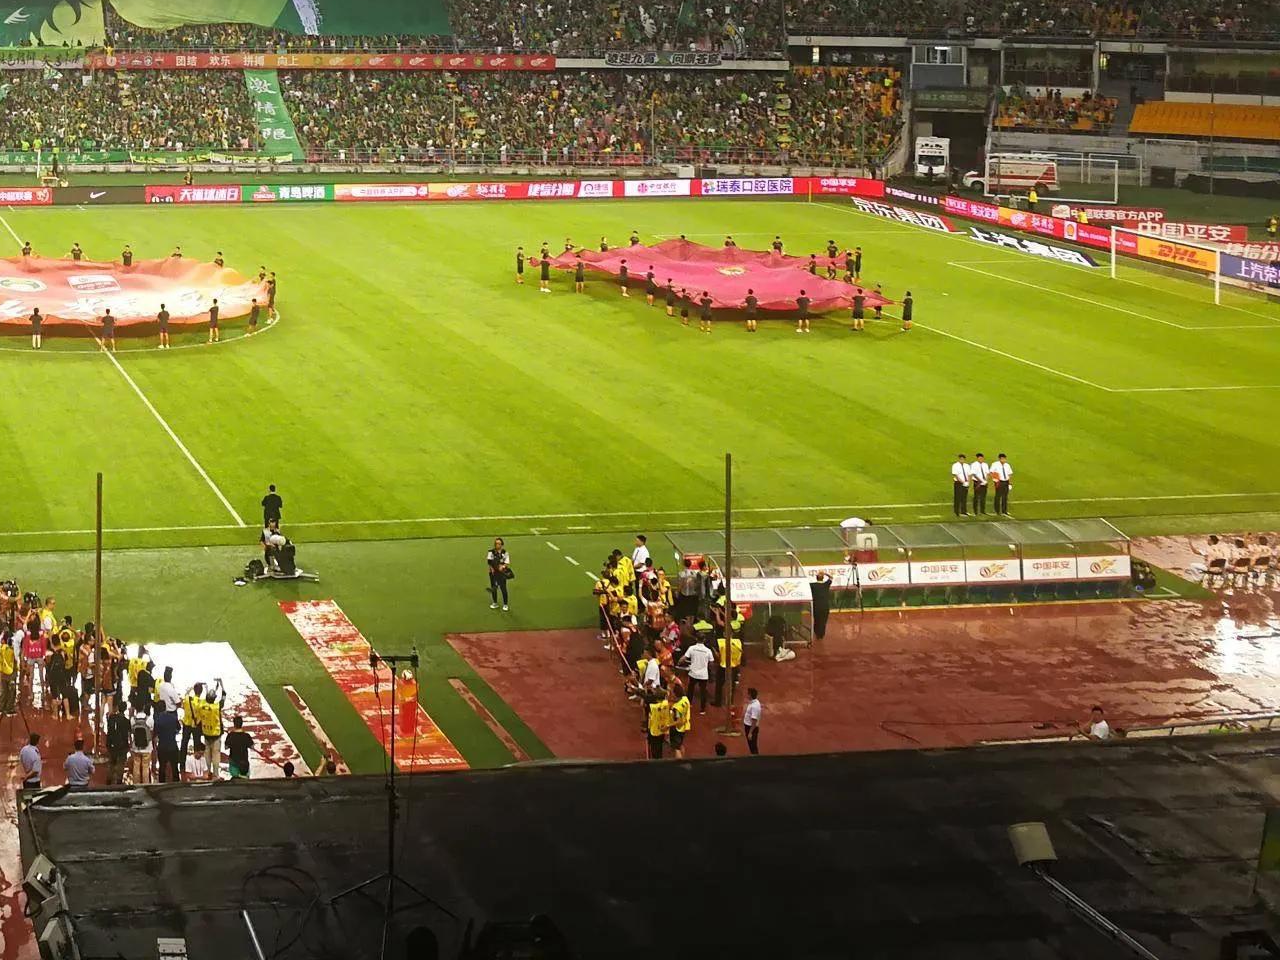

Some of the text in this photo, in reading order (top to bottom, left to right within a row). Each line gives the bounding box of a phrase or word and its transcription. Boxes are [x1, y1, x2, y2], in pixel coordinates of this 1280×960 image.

[716, 180, 792, 193] 瑞泰口腔医院
[1138, 222, 1232, 241] 中国平安
[1236, 260, 1280, 283] 上汽荣
[920, 565, 959, 574] 中国平安
[1033, 561, 1070, 571] 中国平安
